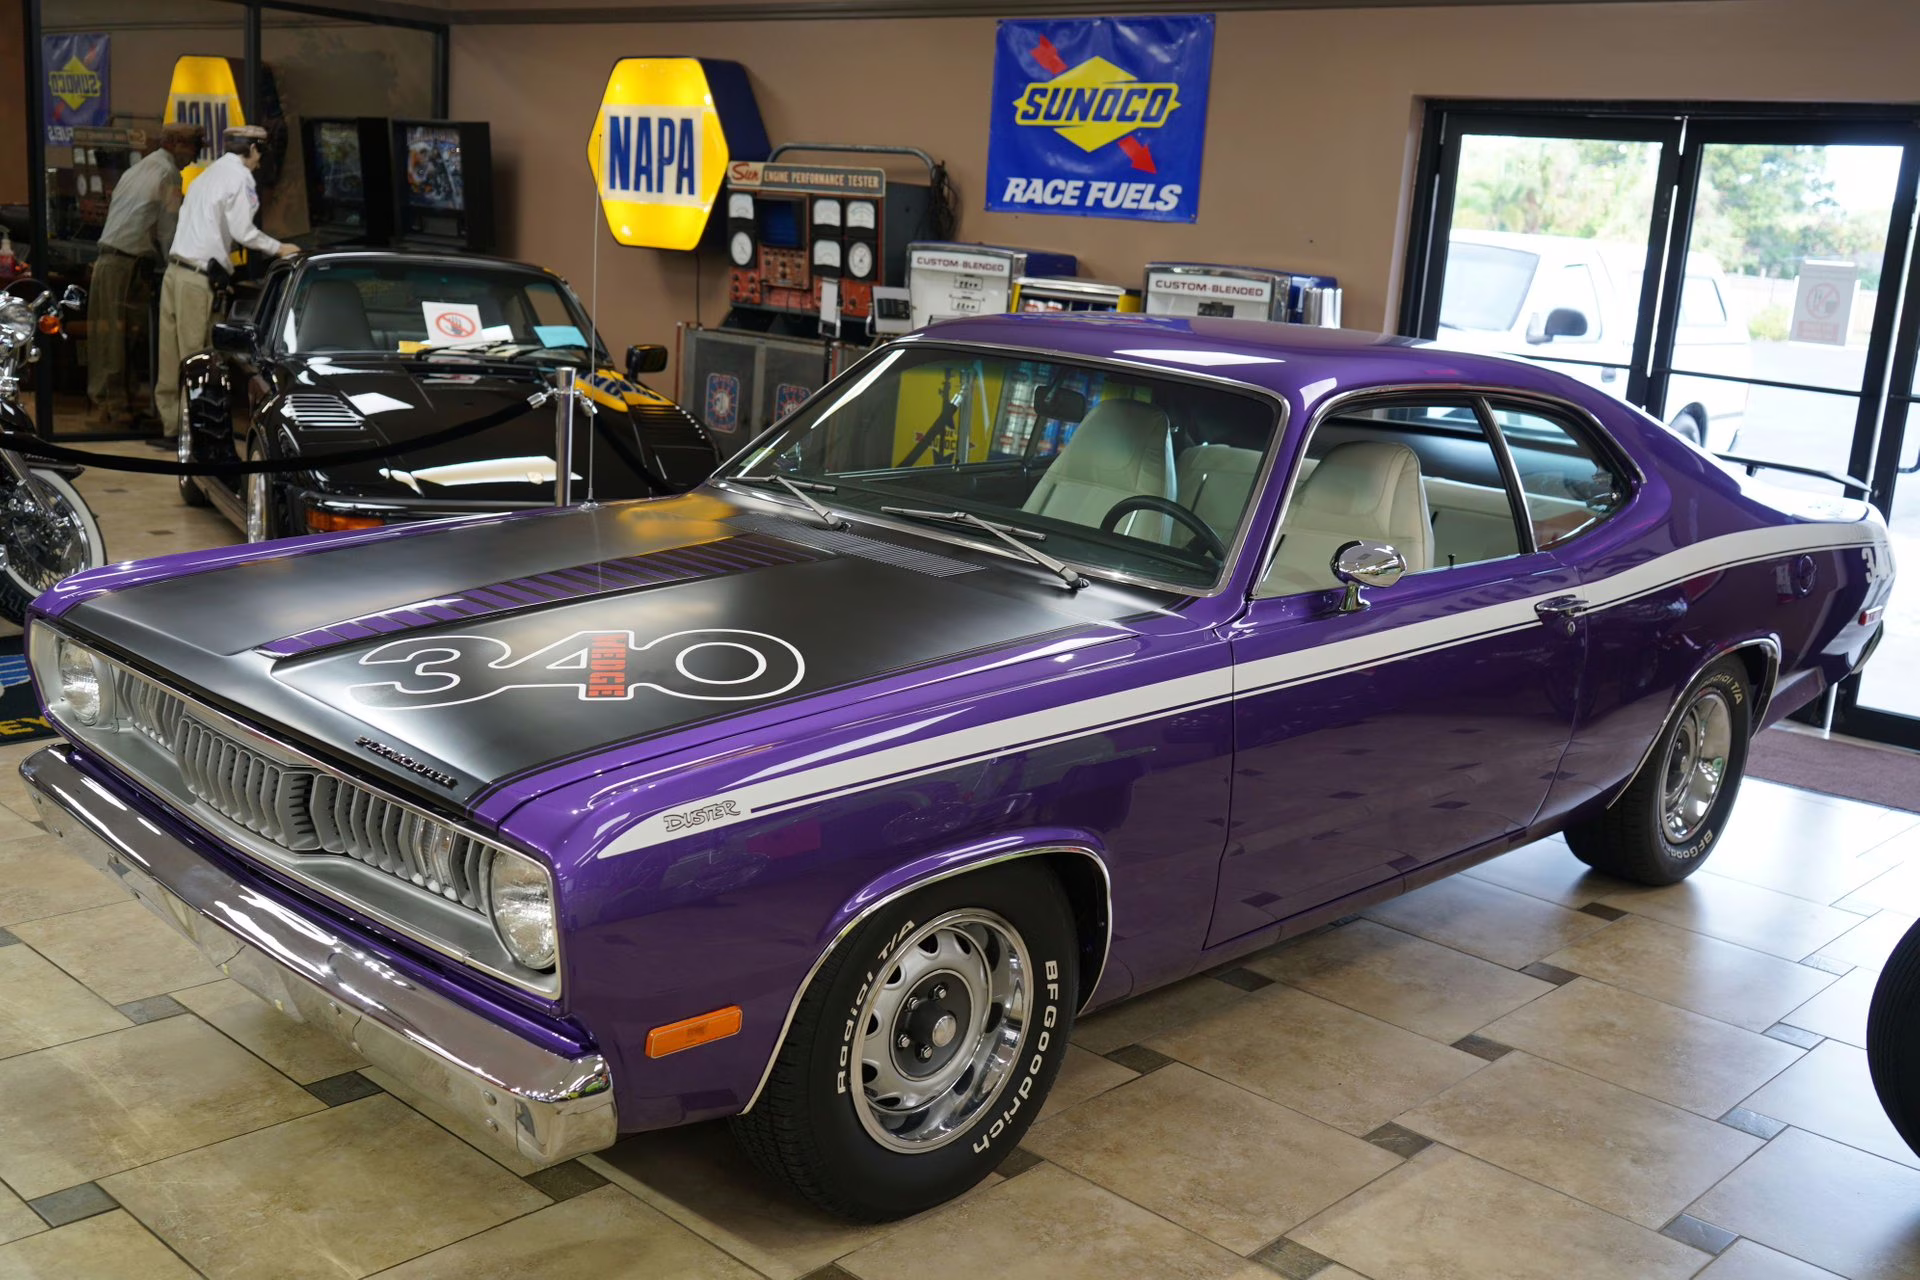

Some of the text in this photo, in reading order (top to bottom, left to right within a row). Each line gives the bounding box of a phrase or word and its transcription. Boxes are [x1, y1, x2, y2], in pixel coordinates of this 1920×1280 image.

[1021, 88, 1173, 122] SUNOCO
[609, 116, 695, 195] NAPA
[732, 162, 880, 188] Sun ENGINE PERFORMANCE TESTER
[1002, 177, 1183, 211] RACE FUELS
[345, 628, 806, 711] 340
[589, 633, 627, 697] WEDGE
[1730, 681, 1744, 704] T/A
[354, 735, 458, 790] PLYMOUTH
[663, 800, 741, 832] DUSTER
[837, 919, 915, 1095] Radial T/A
[973, 960, 1058, 1154] BFGoodrich
